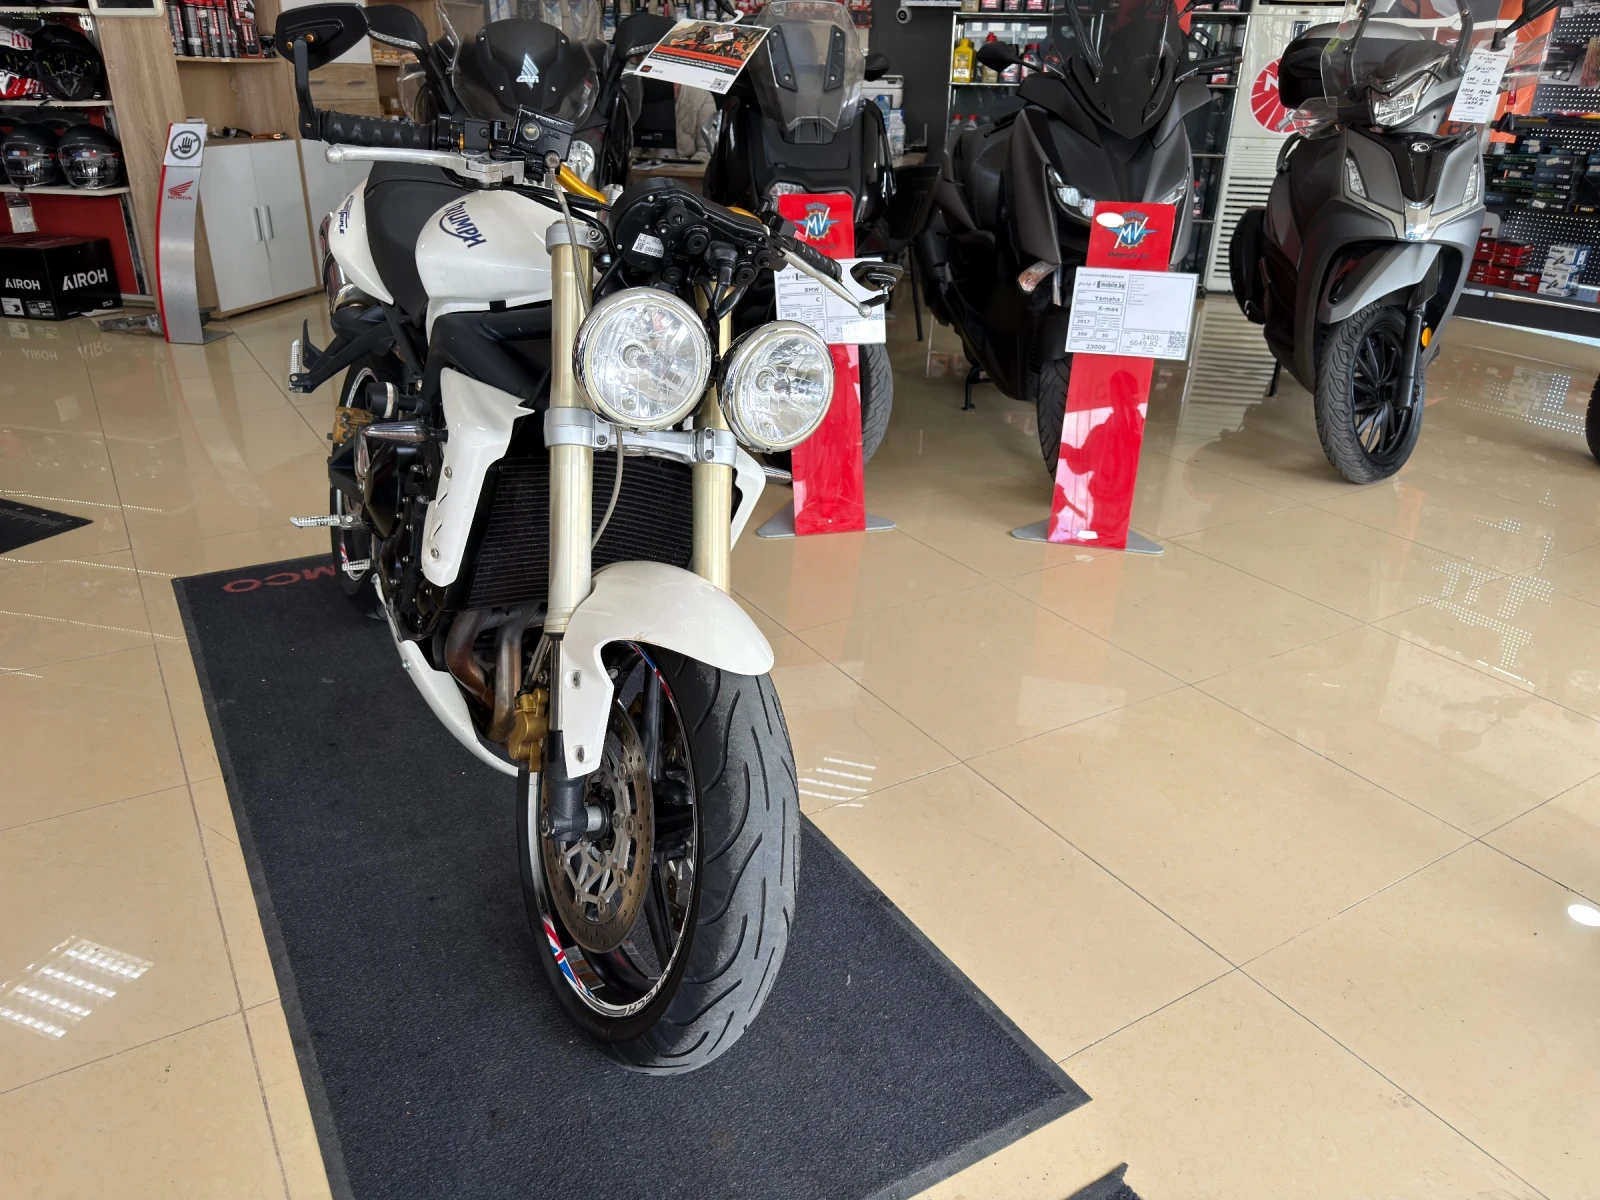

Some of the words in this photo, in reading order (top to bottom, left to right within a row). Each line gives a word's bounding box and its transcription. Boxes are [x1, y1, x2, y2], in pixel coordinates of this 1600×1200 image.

[516, 75, 540, 83] GIVI
[440, 201, 488, 249] TRIUMPH
[805, 207, 830, 239] MV
[1114, 216, 1149, 249] MV
[5, 278, 41, 291] AIROH
[62, 268, 109, 291] AIROH
[1129, 339, 1159, 347] 6649.82
[222, 565, 336, 593] MCO
